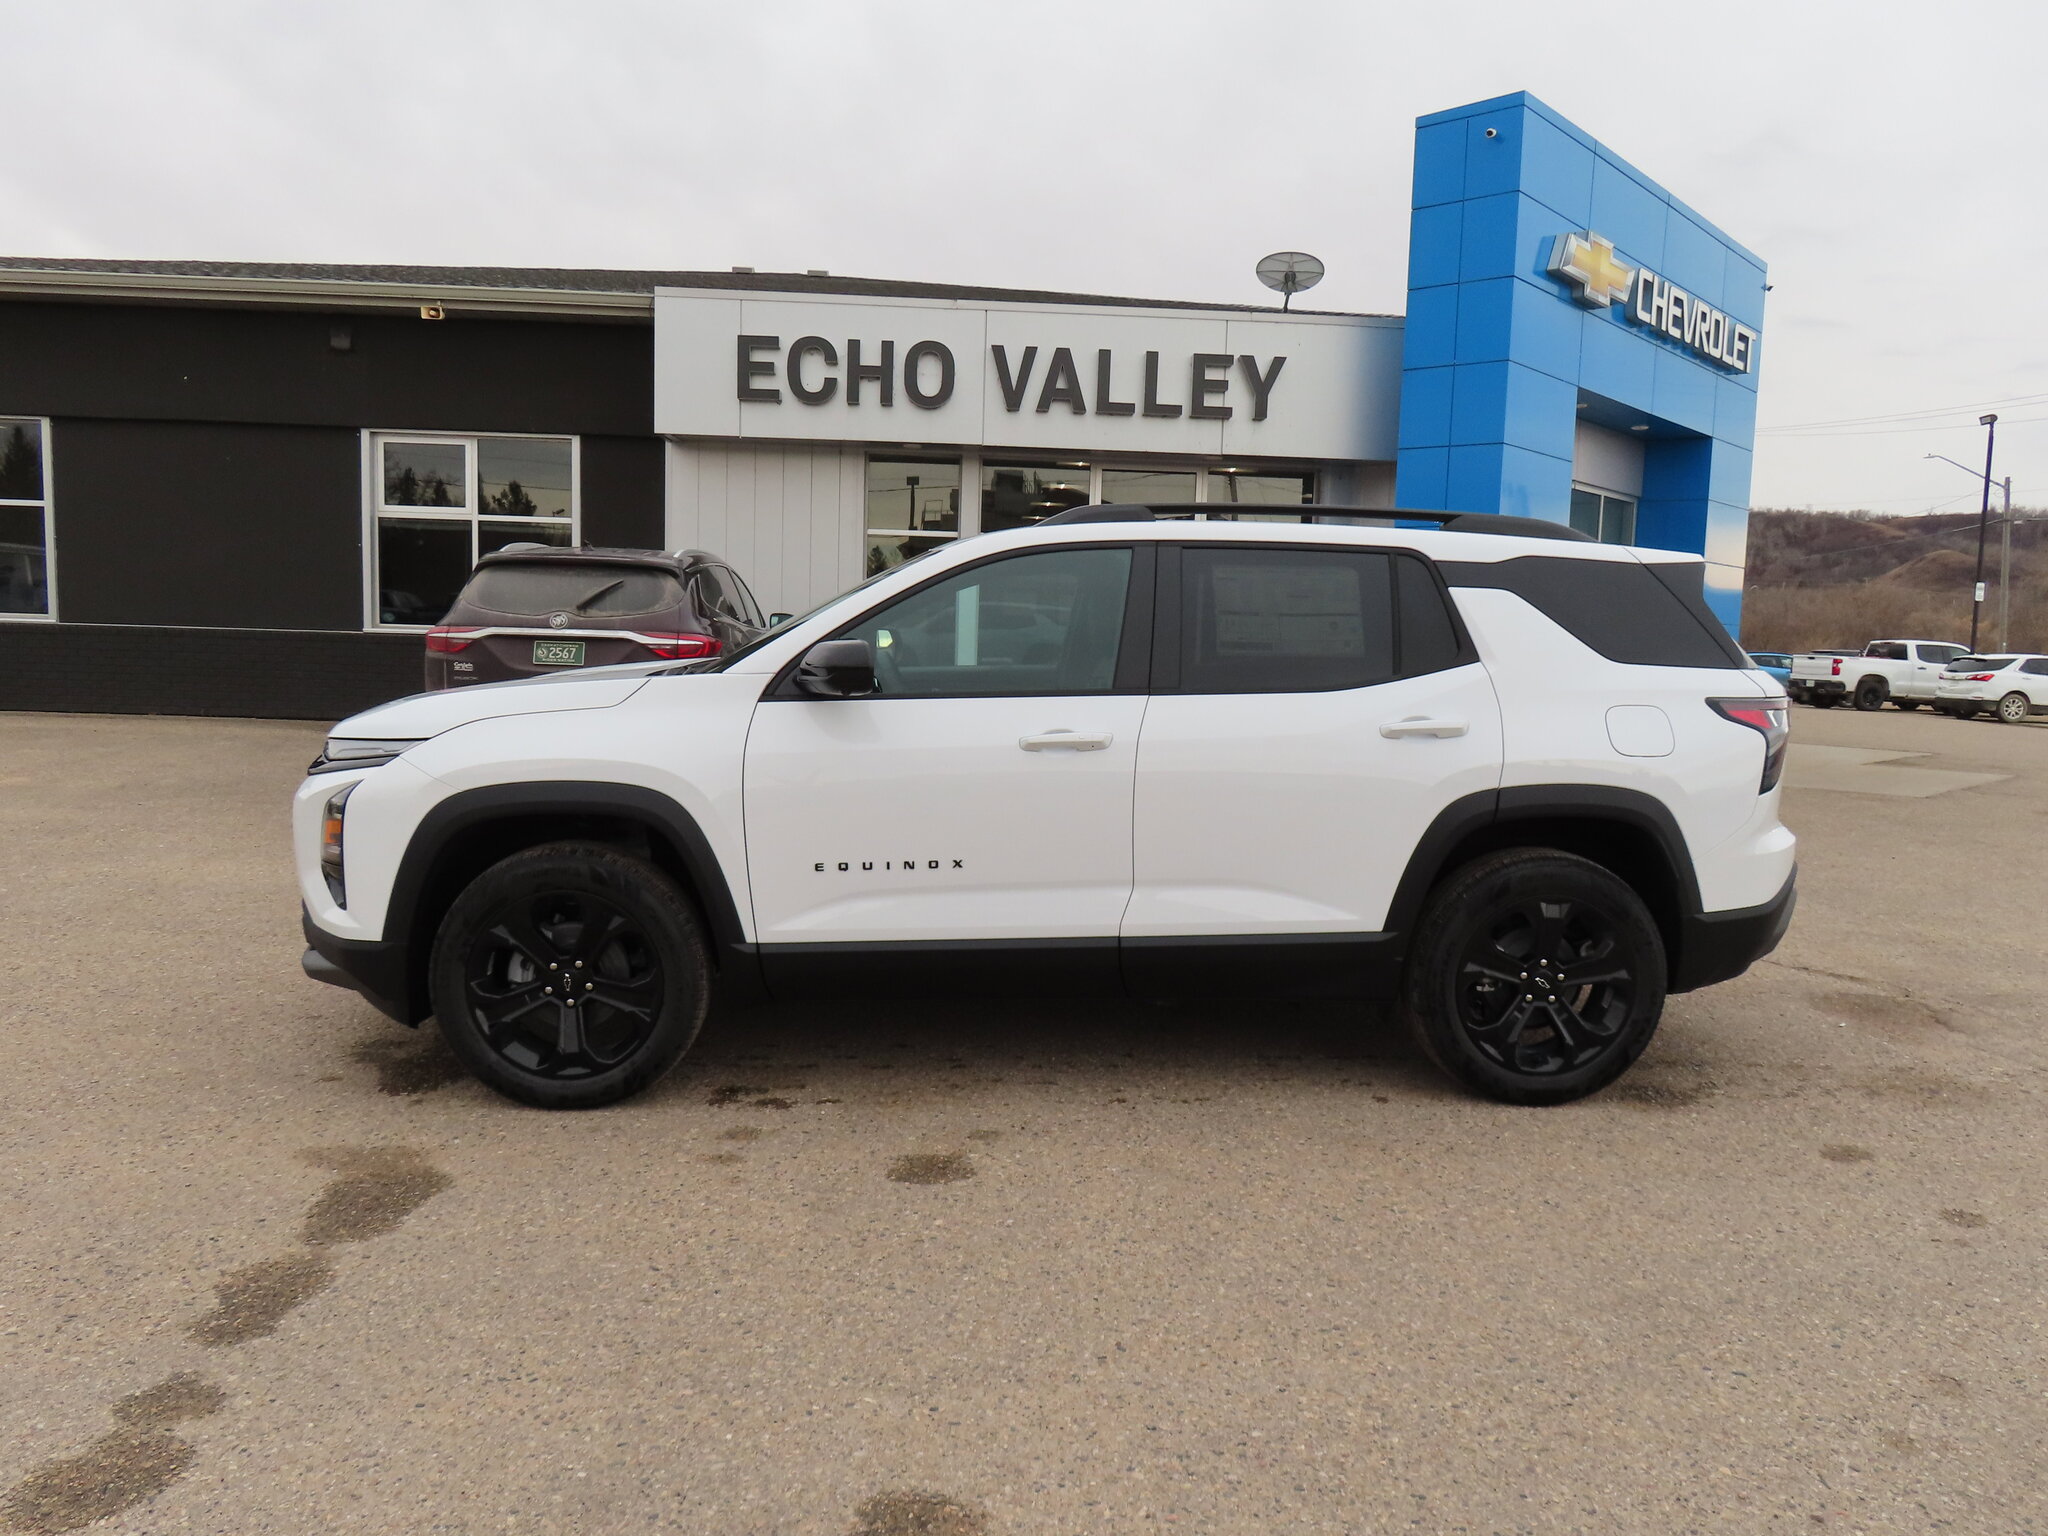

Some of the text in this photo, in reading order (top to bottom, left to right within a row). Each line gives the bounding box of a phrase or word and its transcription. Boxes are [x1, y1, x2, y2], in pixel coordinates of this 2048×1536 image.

[1636, 267, 1756, 374] CHEVROLET
[737, 334, 1287, 422] ECHO VALLEY
[549, 647, 576, 659] 2567
[814, 859, 963, 872] EQUINOX
